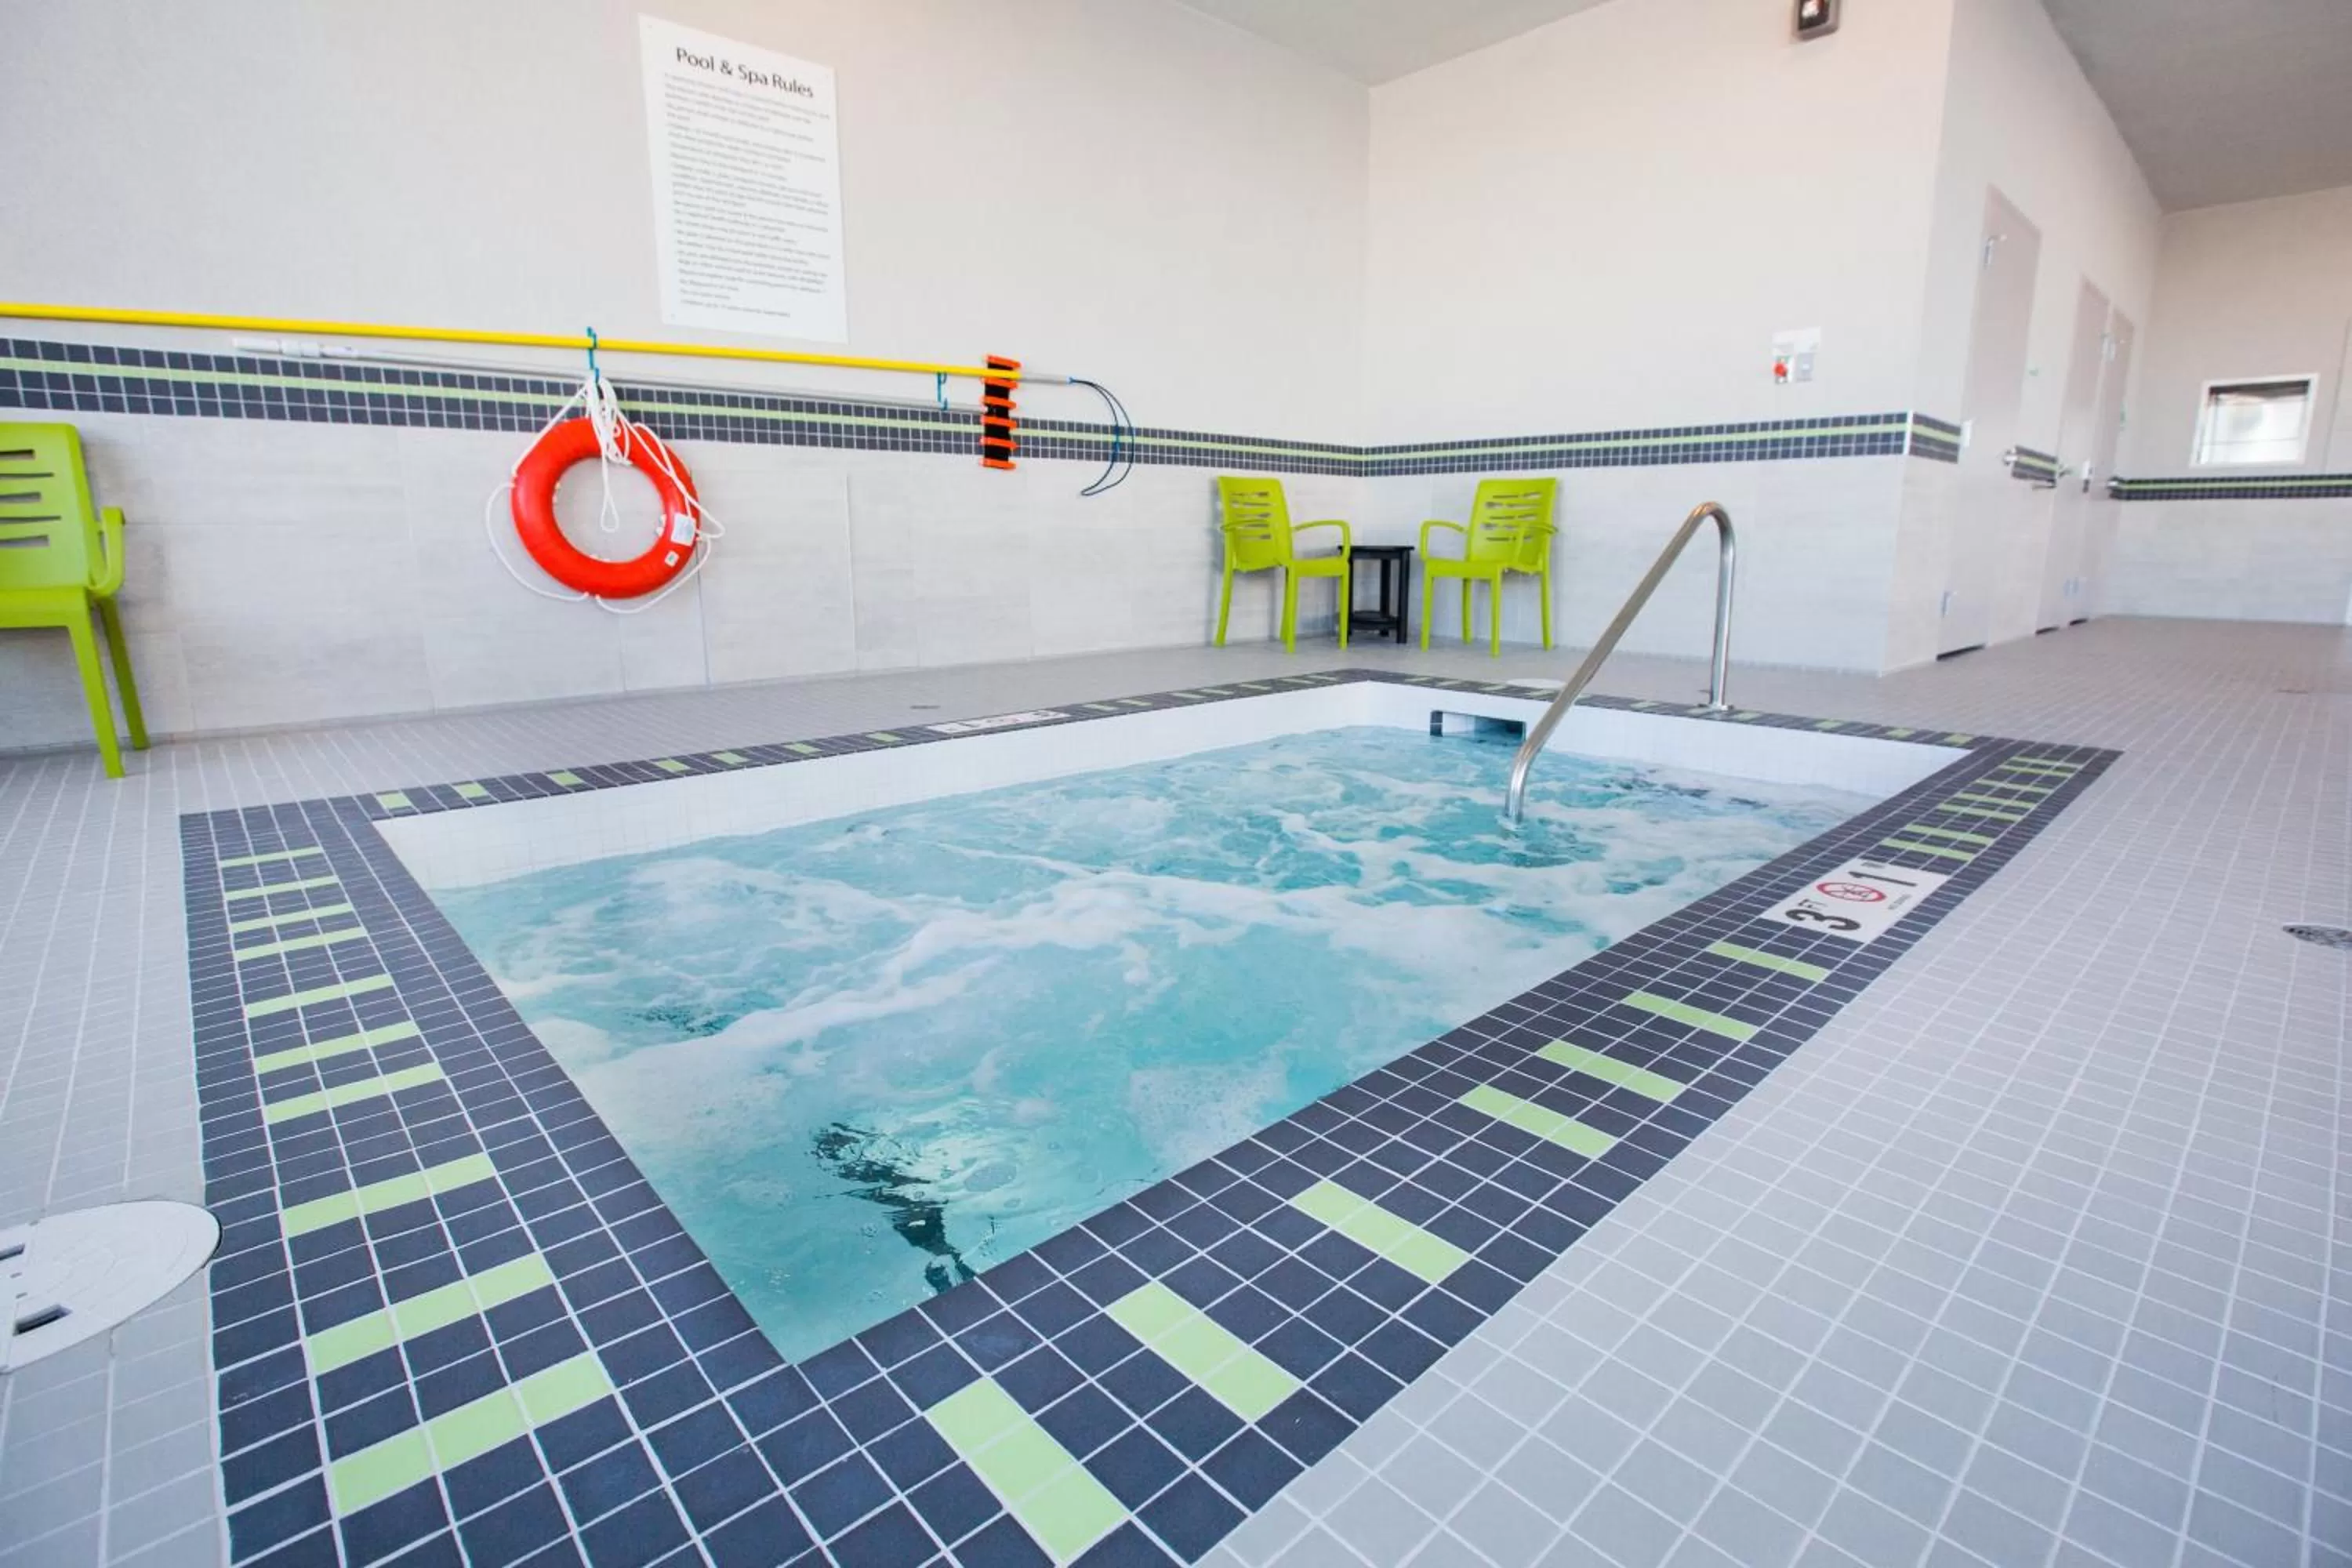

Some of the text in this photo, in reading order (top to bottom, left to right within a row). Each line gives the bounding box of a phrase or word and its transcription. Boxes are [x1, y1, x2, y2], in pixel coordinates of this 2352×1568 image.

[676, 47, 814, 98] Pool & Spa Rules
[1785, 909, 1860, 931] 3
